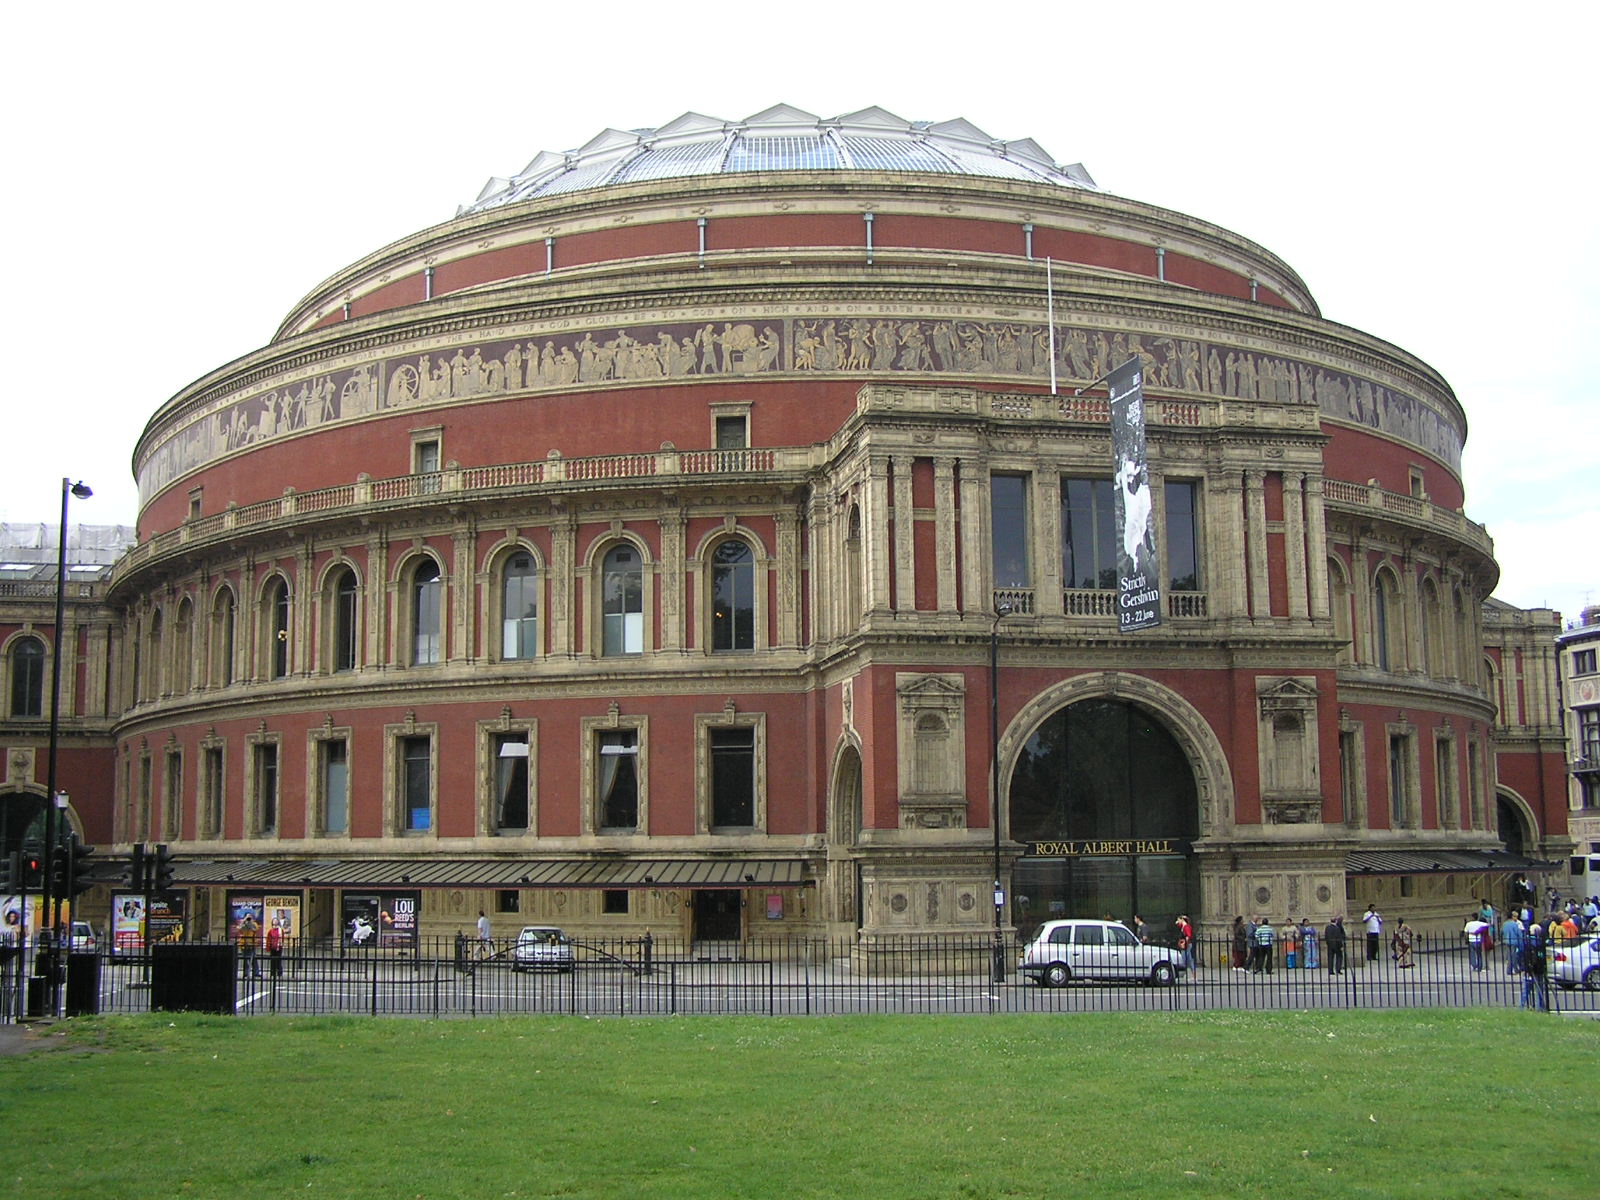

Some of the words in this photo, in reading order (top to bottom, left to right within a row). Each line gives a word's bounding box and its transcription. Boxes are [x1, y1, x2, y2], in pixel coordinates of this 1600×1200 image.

[447, 334, 463, 343] THE
[479, 329, 505, 338] HAND
[523, 324, 535, 332] OF
[549, 320, 570, 329] GOD
[585, 315, 618, 325] GLORY
[662, 310, 675, 319] TO
[692, 308, 714, 317] GOD
[731, 306, 746, 315] ON
[763, 305, 789, 314] HIGH
[806, 305, 829, 313] AND
[846, 304, 861, 313] ON
[878, 305, 913, 313] EARTH
[929, 306, 962, 314] PEACE
[1087, 316, 1111, 326] HALL
[1159, 323, 1195, 336] ERECTED
[1207, 330, 1223, 340] FOR
[1121, 572, 1146, 591] Strictly
[1121, 587, 1159, 608] Gershwin
[1121, 612, 1130, 624] 13
[1135, 610, 1142, 622] 22
[1143, 609, 1154, 621] June
[1036, 842, 1078, 855] ROYAL
[1082, 841, 1133, 854] ALBERT
[1136, 840, 1172, 853] HALL
[395, 900, 414, 913] LOU
[394, 913, 415, 922] REED'S
